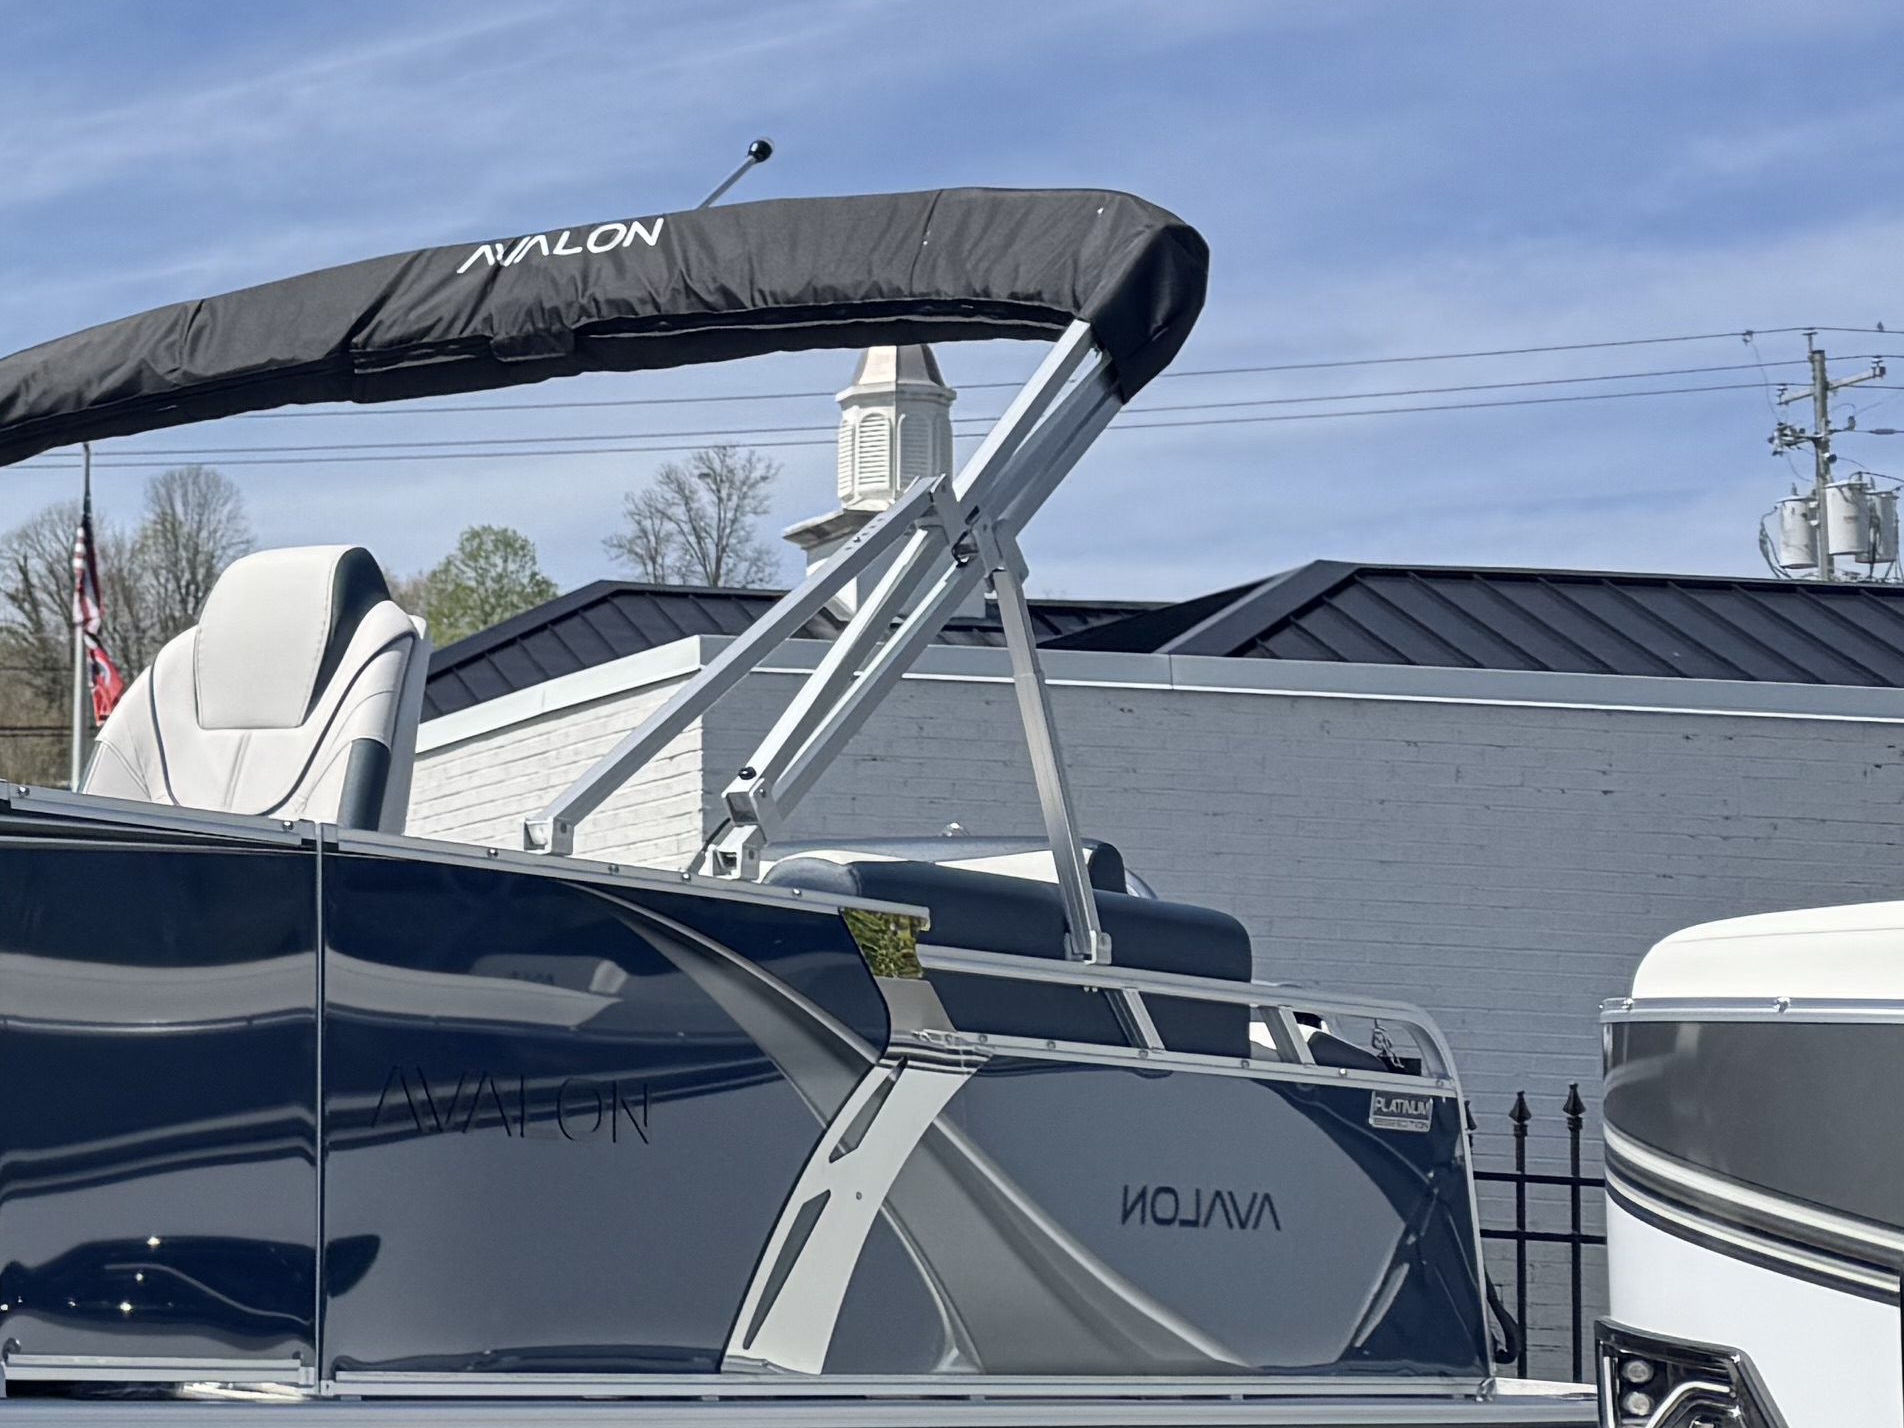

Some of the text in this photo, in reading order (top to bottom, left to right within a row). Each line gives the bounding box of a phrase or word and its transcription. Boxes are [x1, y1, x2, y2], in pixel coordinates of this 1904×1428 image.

[456, 217, 665, 274] AVALON
[370, 1065, 649, 1145] AVALON
[1374, 1096, 1431, 1115] PLATINUM
